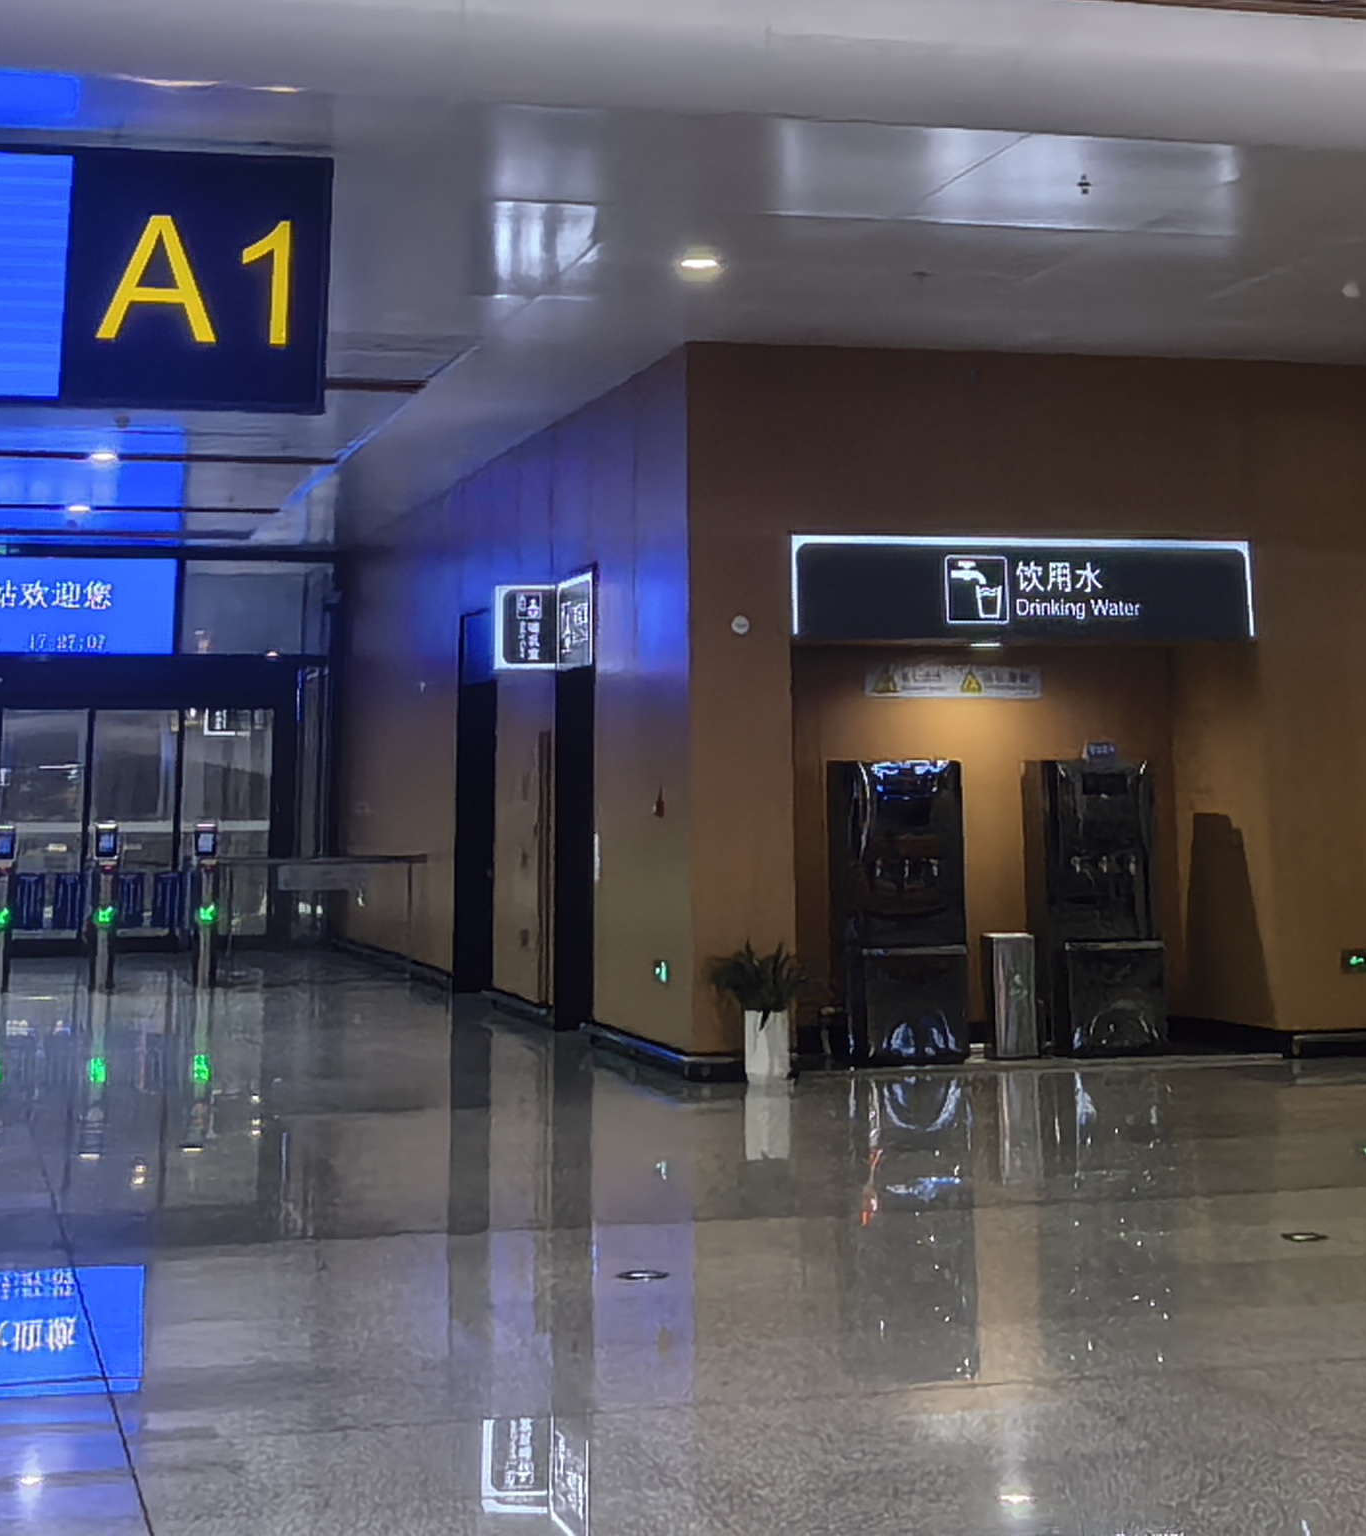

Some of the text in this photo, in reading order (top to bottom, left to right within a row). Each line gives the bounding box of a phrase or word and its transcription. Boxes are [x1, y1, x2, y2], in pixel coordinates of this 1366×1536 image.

[96, 215, 290, 344] A1
[1016, 561, 1102, 594] 饮用水
[1016, 598, 1140, 620] Drinking Water
